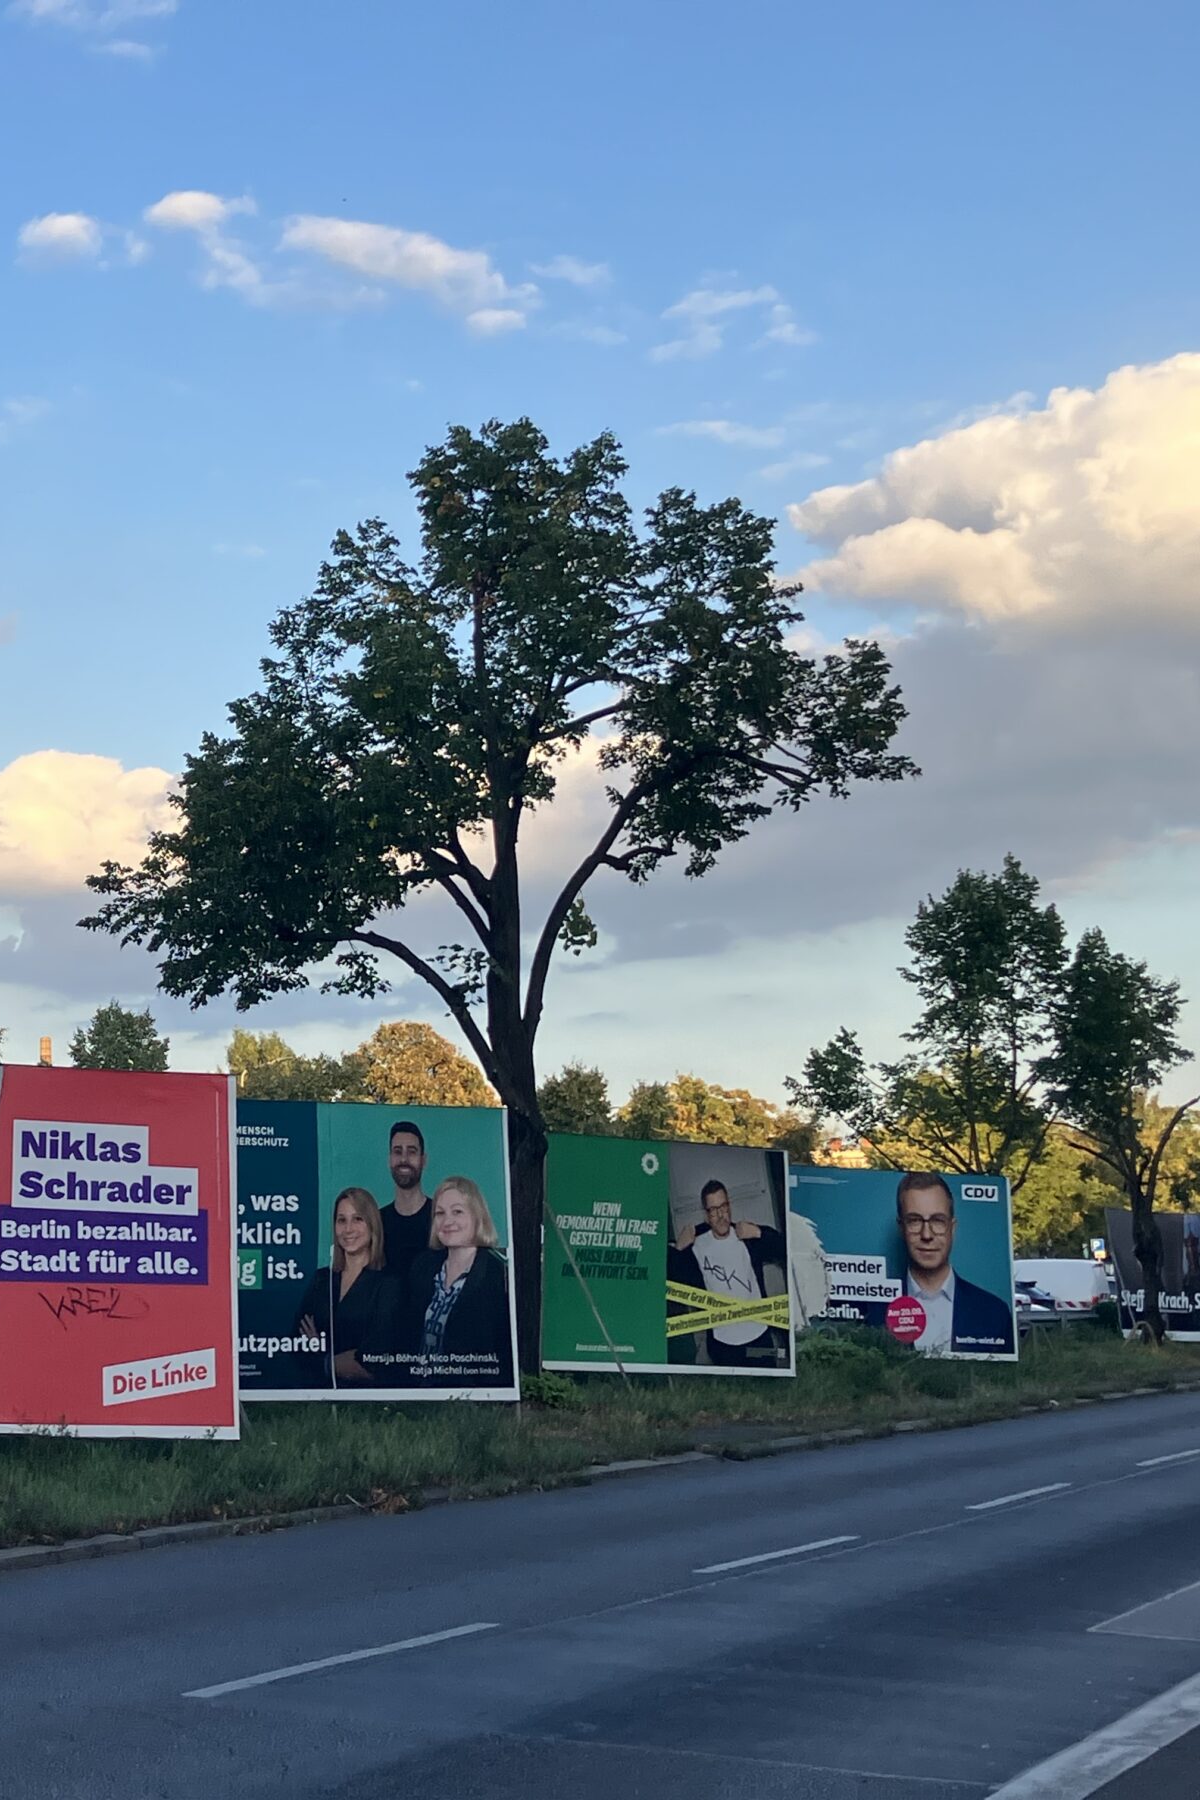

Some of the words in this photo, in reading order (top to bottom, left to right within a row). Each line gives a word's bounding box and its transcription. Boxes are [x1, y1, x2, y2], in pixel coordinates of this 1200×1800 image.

[20, 1129, 142, 1164] Niklas
[18, 1170, 192, 1206] Schrader
[964, 1186, 996, 1199] CDU
[250, 1194, 299, 1212] was
[593, 1201, 622, 1217] WENN
[0, 1219, 71, 1240] Berlin
[77, 1220, 198, 1243] bezahlbar.
[556, 1214, 616, 1233] DEMOKRATIE
[615, 1218, 627, 1233] IN
[627, 1219, 659, 1235] FRAGE
[569, 1231, 615, 1247] GESTELLT
[615, 1233, 642, 1251] WIRD,
[0, 1249, 81, 1273] Stadt
[87, 1250, 131, 1274] für
[137, 1251, 199, 1275] alle.
[267, 1256, 304, 1280] ist.
[1158, 1291, 1193, 1312] Krach,
[429, 1353, 449, 1363] Nico
[112, 1373, 147, 1395] Die
[151, 1361, 208, 1389] Linke
[409, 1365, 433, 1377] Katja
[433, 1365, 462, 1375] Michel
